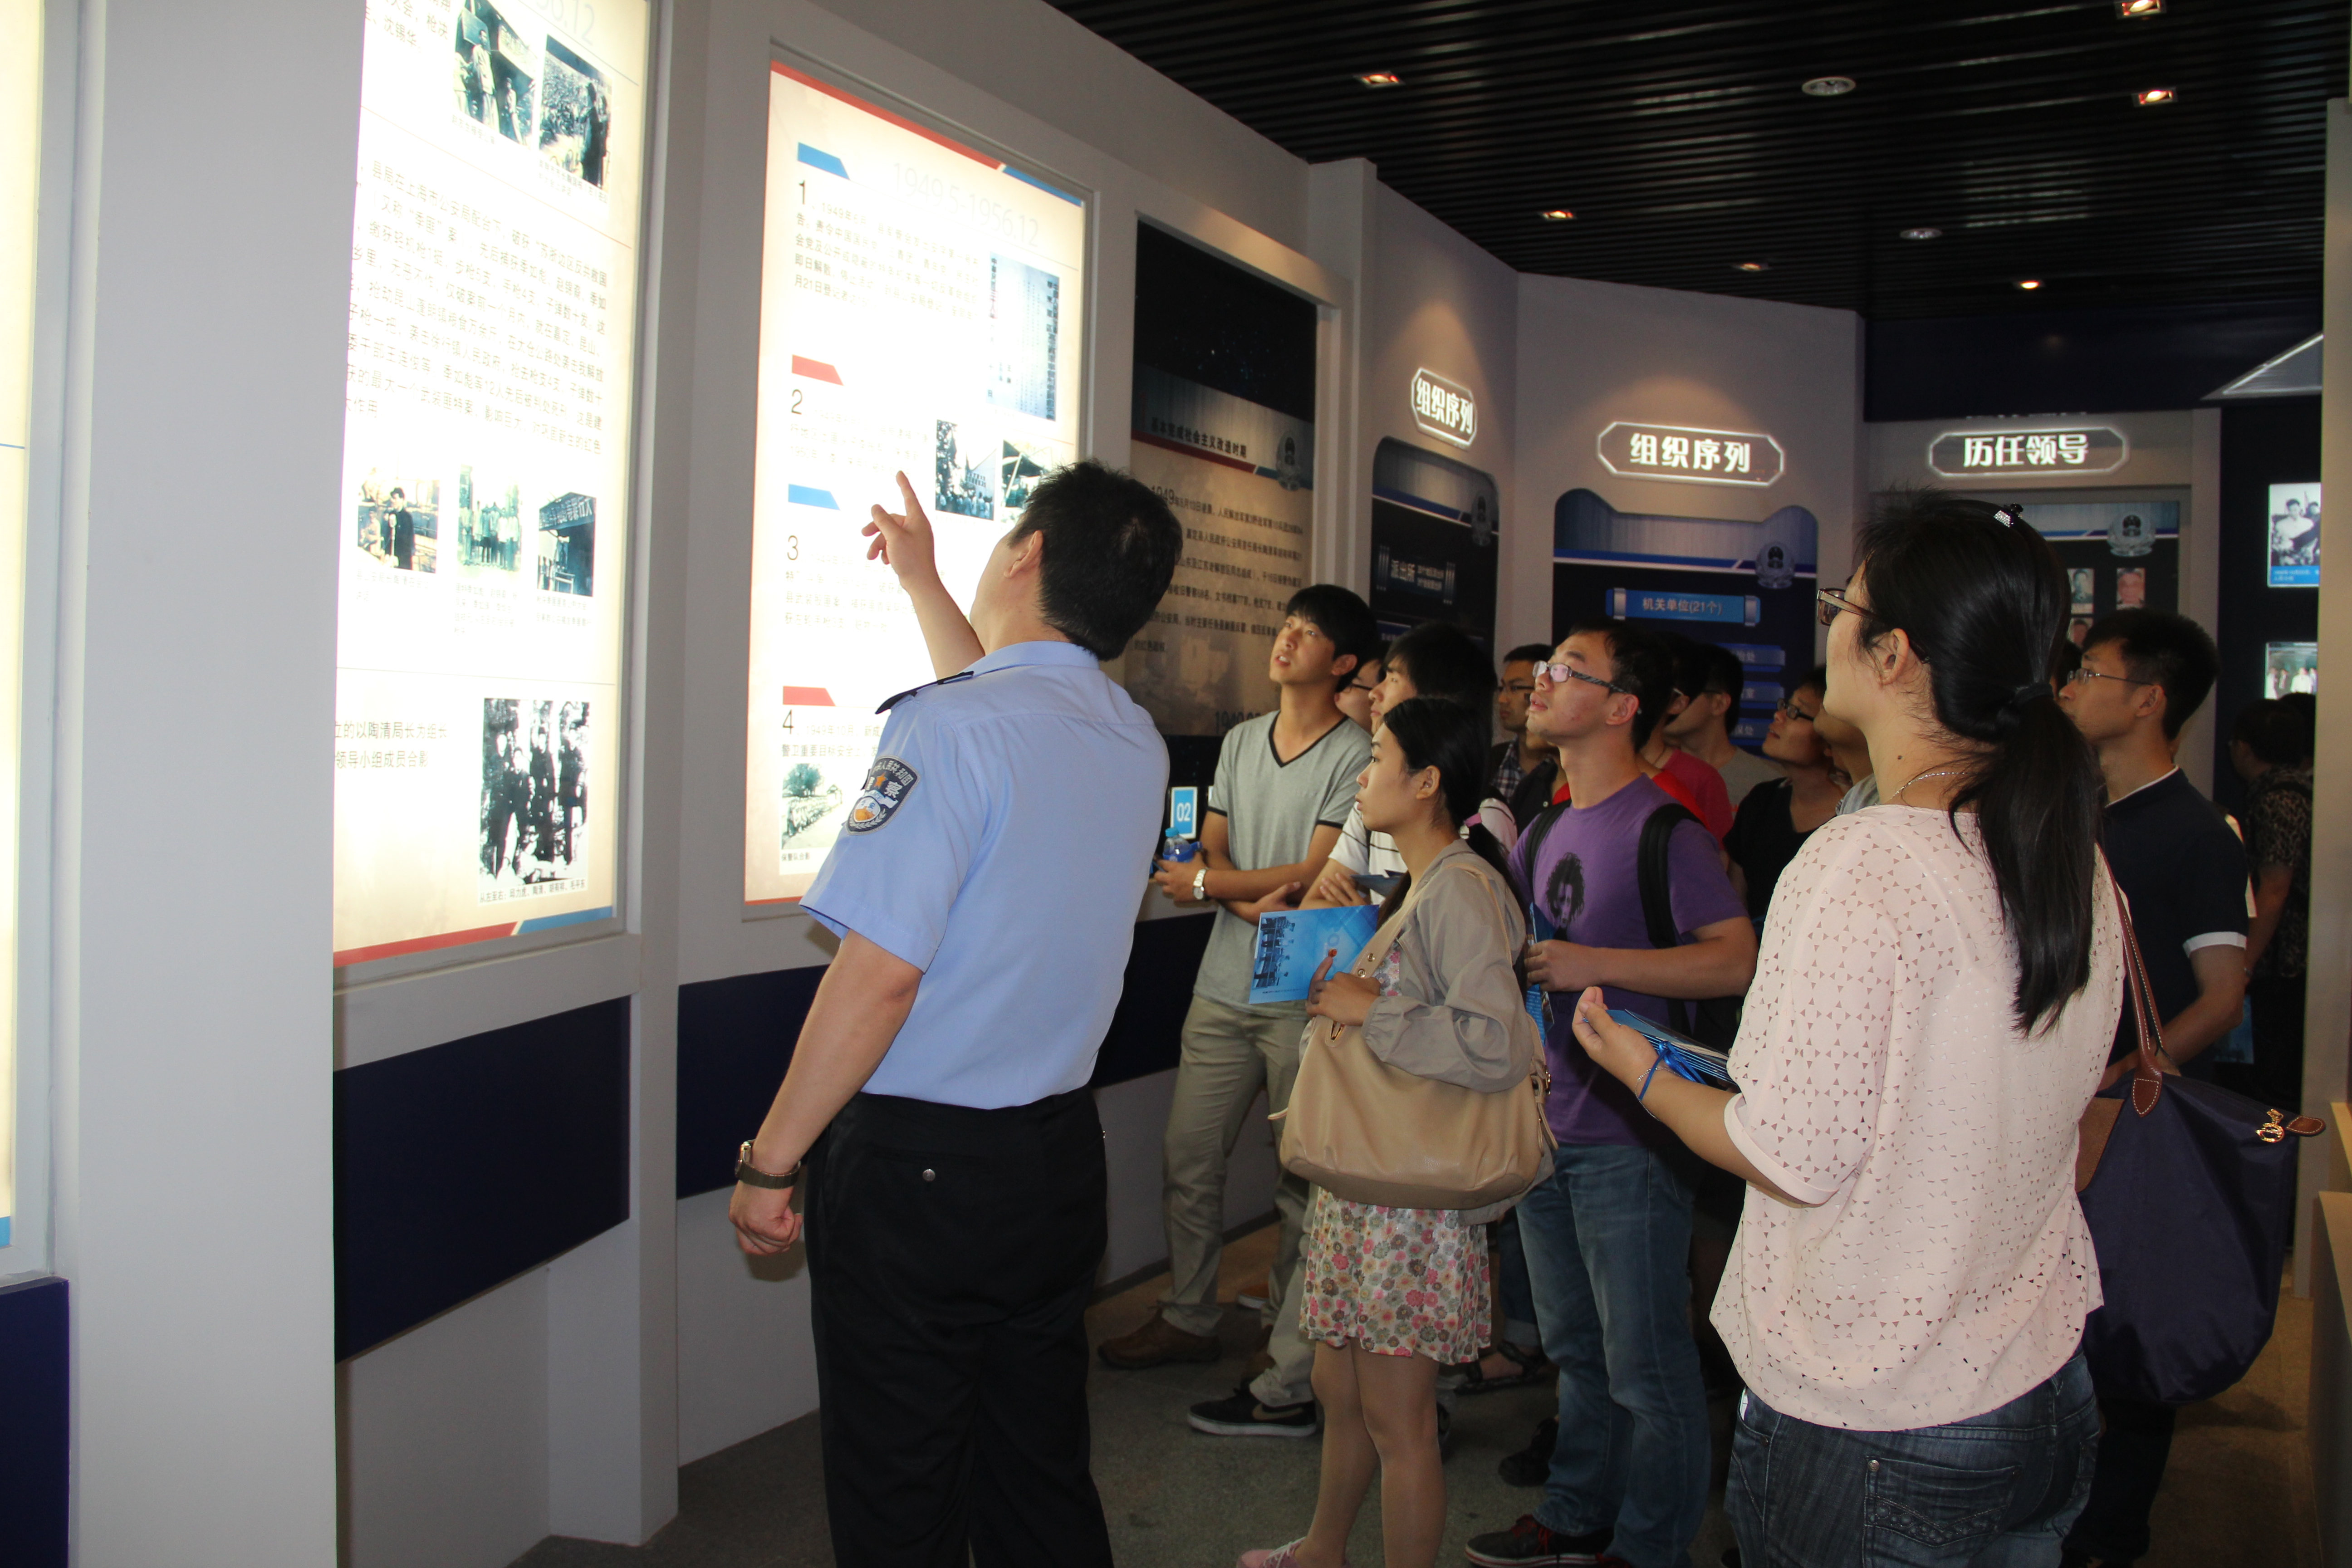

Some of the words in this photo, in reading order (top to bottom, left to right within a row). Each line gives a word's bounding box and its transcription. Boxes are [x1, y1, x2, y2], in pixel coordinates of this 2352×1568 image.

[893, 162, 1039, 248] 1949.5-1956.12
[1415, 377, 1474, 434] 组织序列
[1629, 431, 1752, 474] 组织序列
[1963, 433, 2089, 468] 历任领导
[1390, 559, 1416, 583] 派出所
[1642, 596, 1723, 615] 机关单位(21个)
[336, 750, 429, 769] 领导小组成员合影
[1176, 801, 1191, 823] 02
